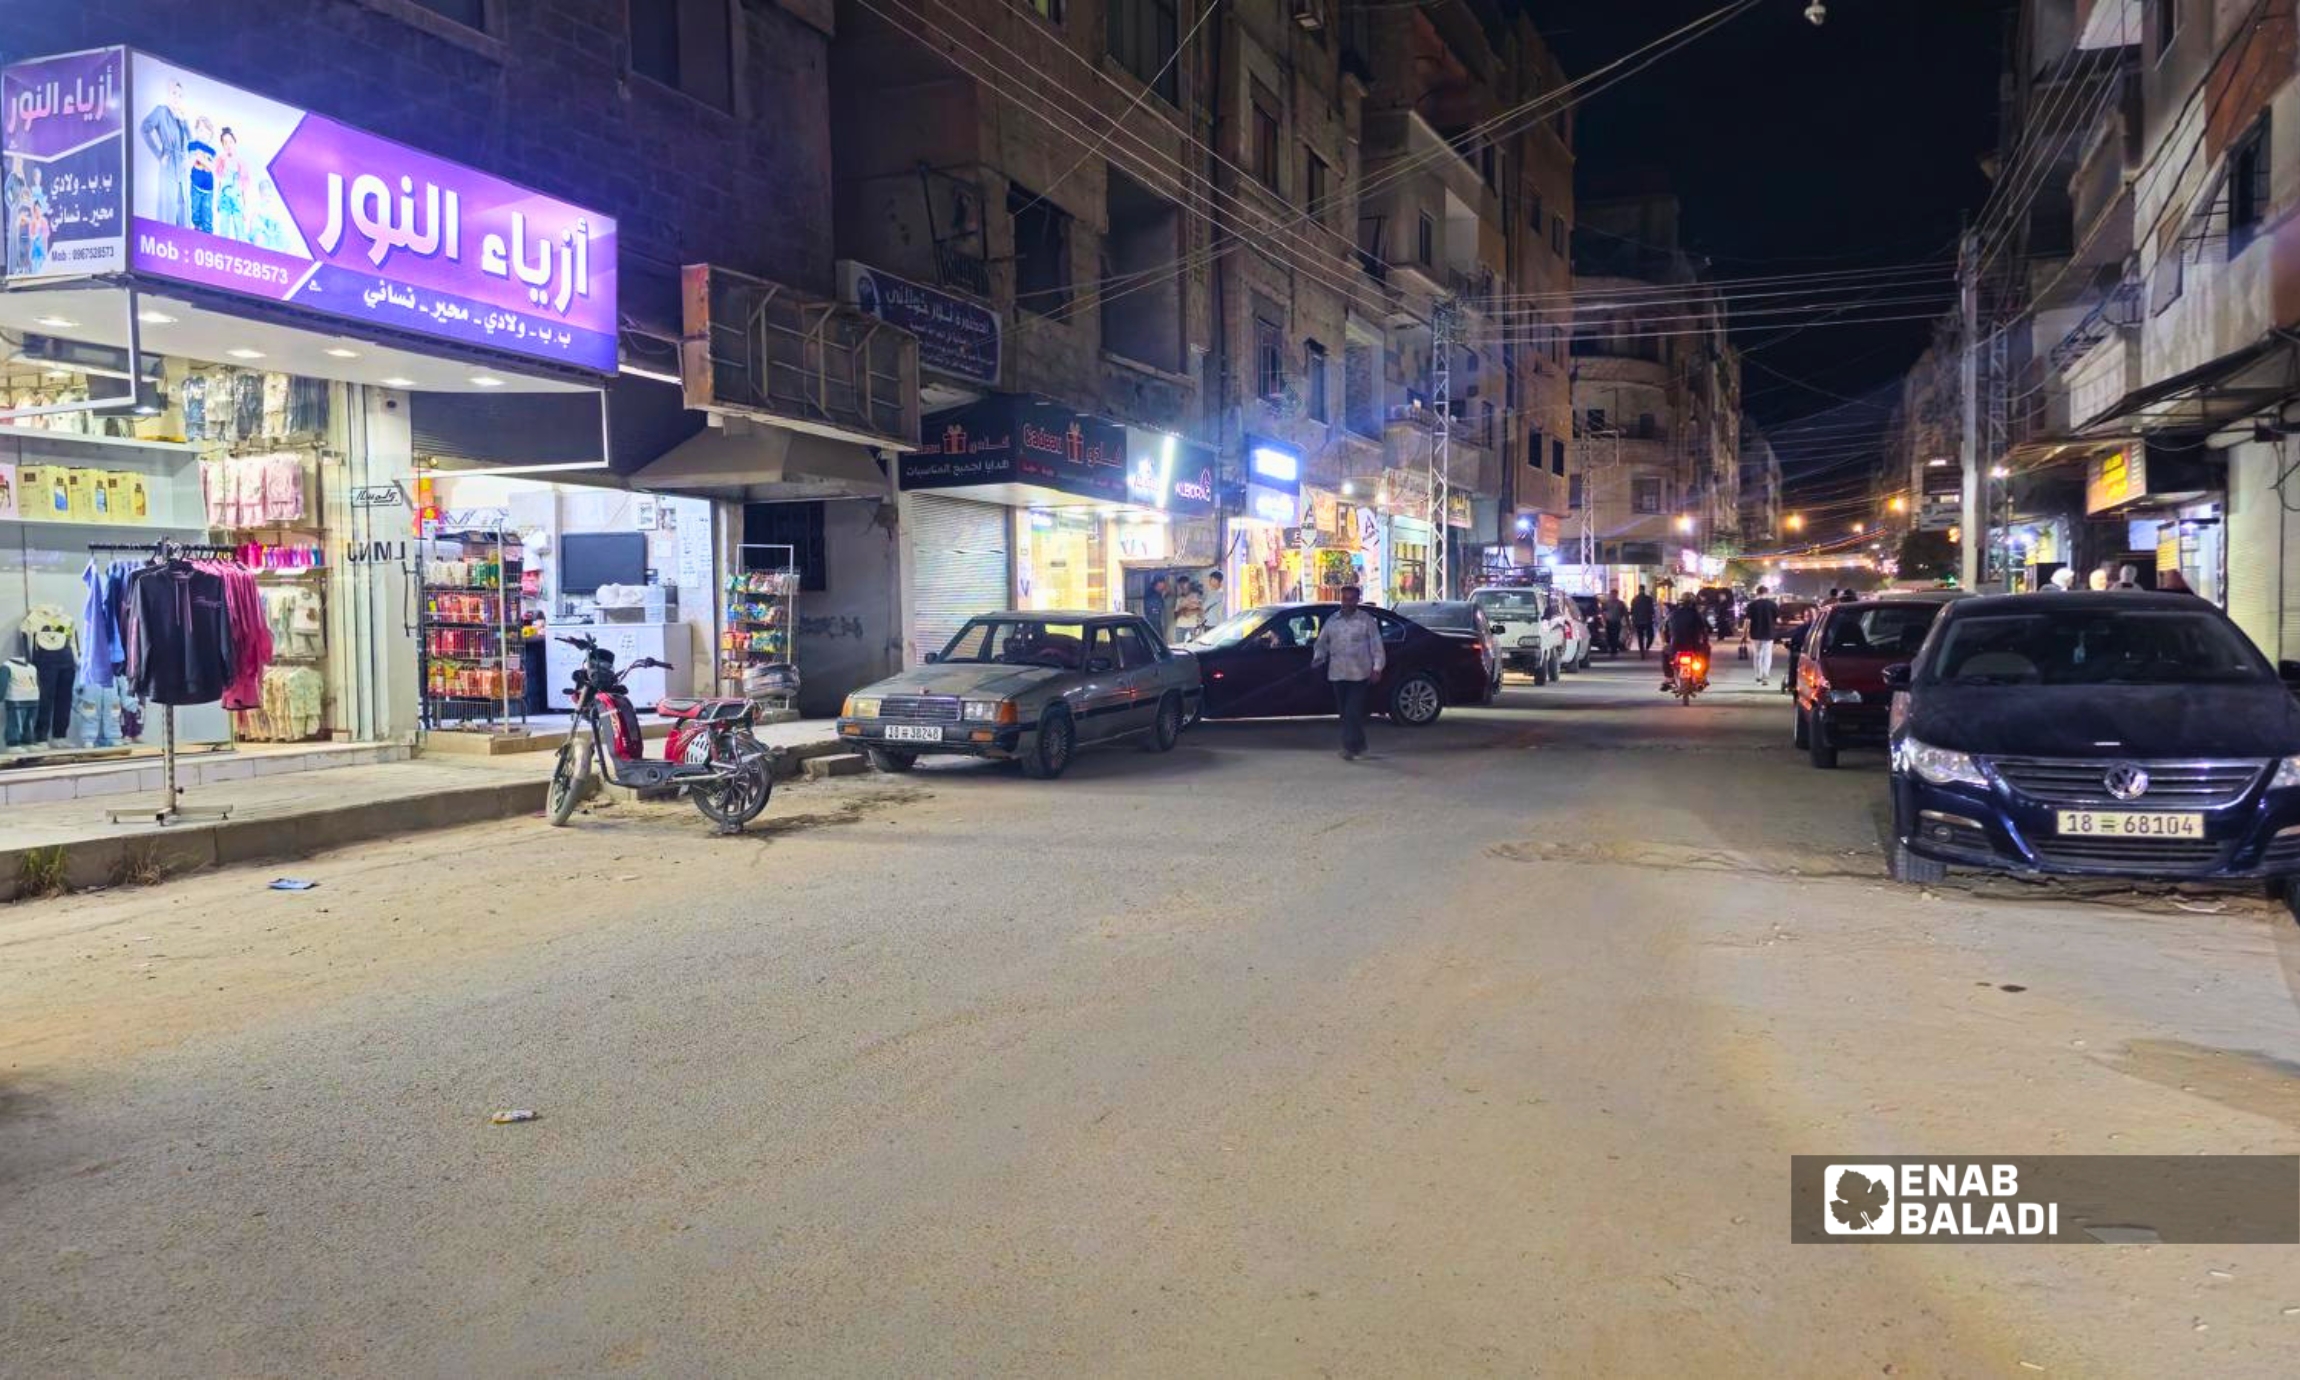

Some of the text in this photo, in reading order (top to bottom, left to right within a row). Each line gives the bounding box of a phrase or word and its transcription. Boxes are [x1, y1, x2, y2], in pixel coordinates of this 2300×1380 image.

[8, 65, 113, 133] أزياء النور
[52, 250, 67, 261] Mob
[140, 234, 179, 261] Mob
[194, 248, 289, 285] 0967528573
[317, 172, 589, 313] أزياء النور
[484, 312, 526, 338] ولادي
[2066, 813, 2194, 835] 18 68104
